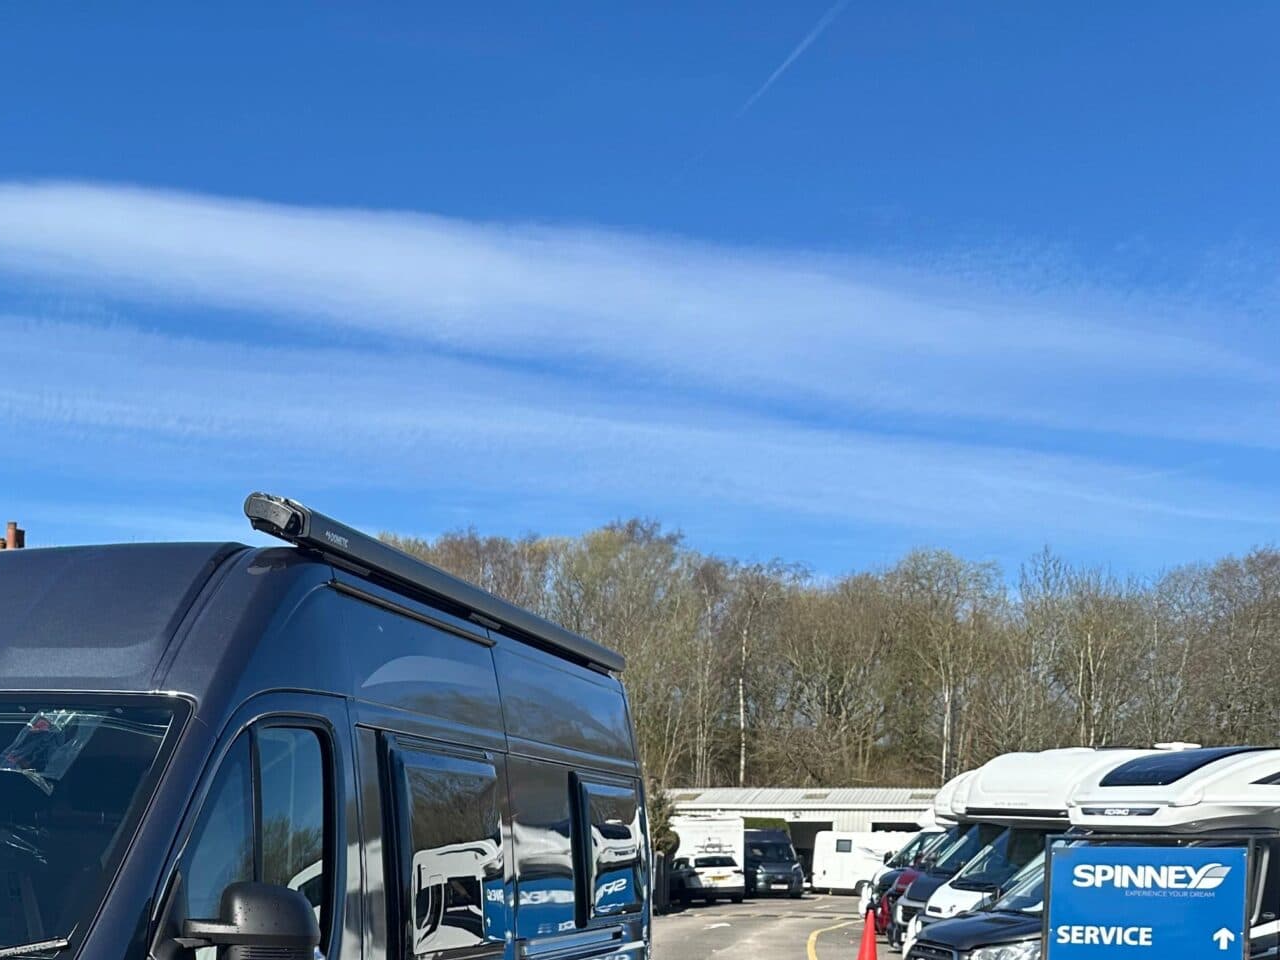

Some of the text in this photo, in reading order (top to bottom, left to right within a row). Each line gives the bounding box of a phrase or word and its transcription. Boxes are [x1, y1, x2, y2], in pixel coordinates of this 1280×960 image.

[1072, 863, 1224, 889] SPINNEY
[1125, 890, 1168, 898] EXPERIENCE
[1168, 890, 1188, 898] YOUR
[1056, 925, 1153, 946] SERVICE
